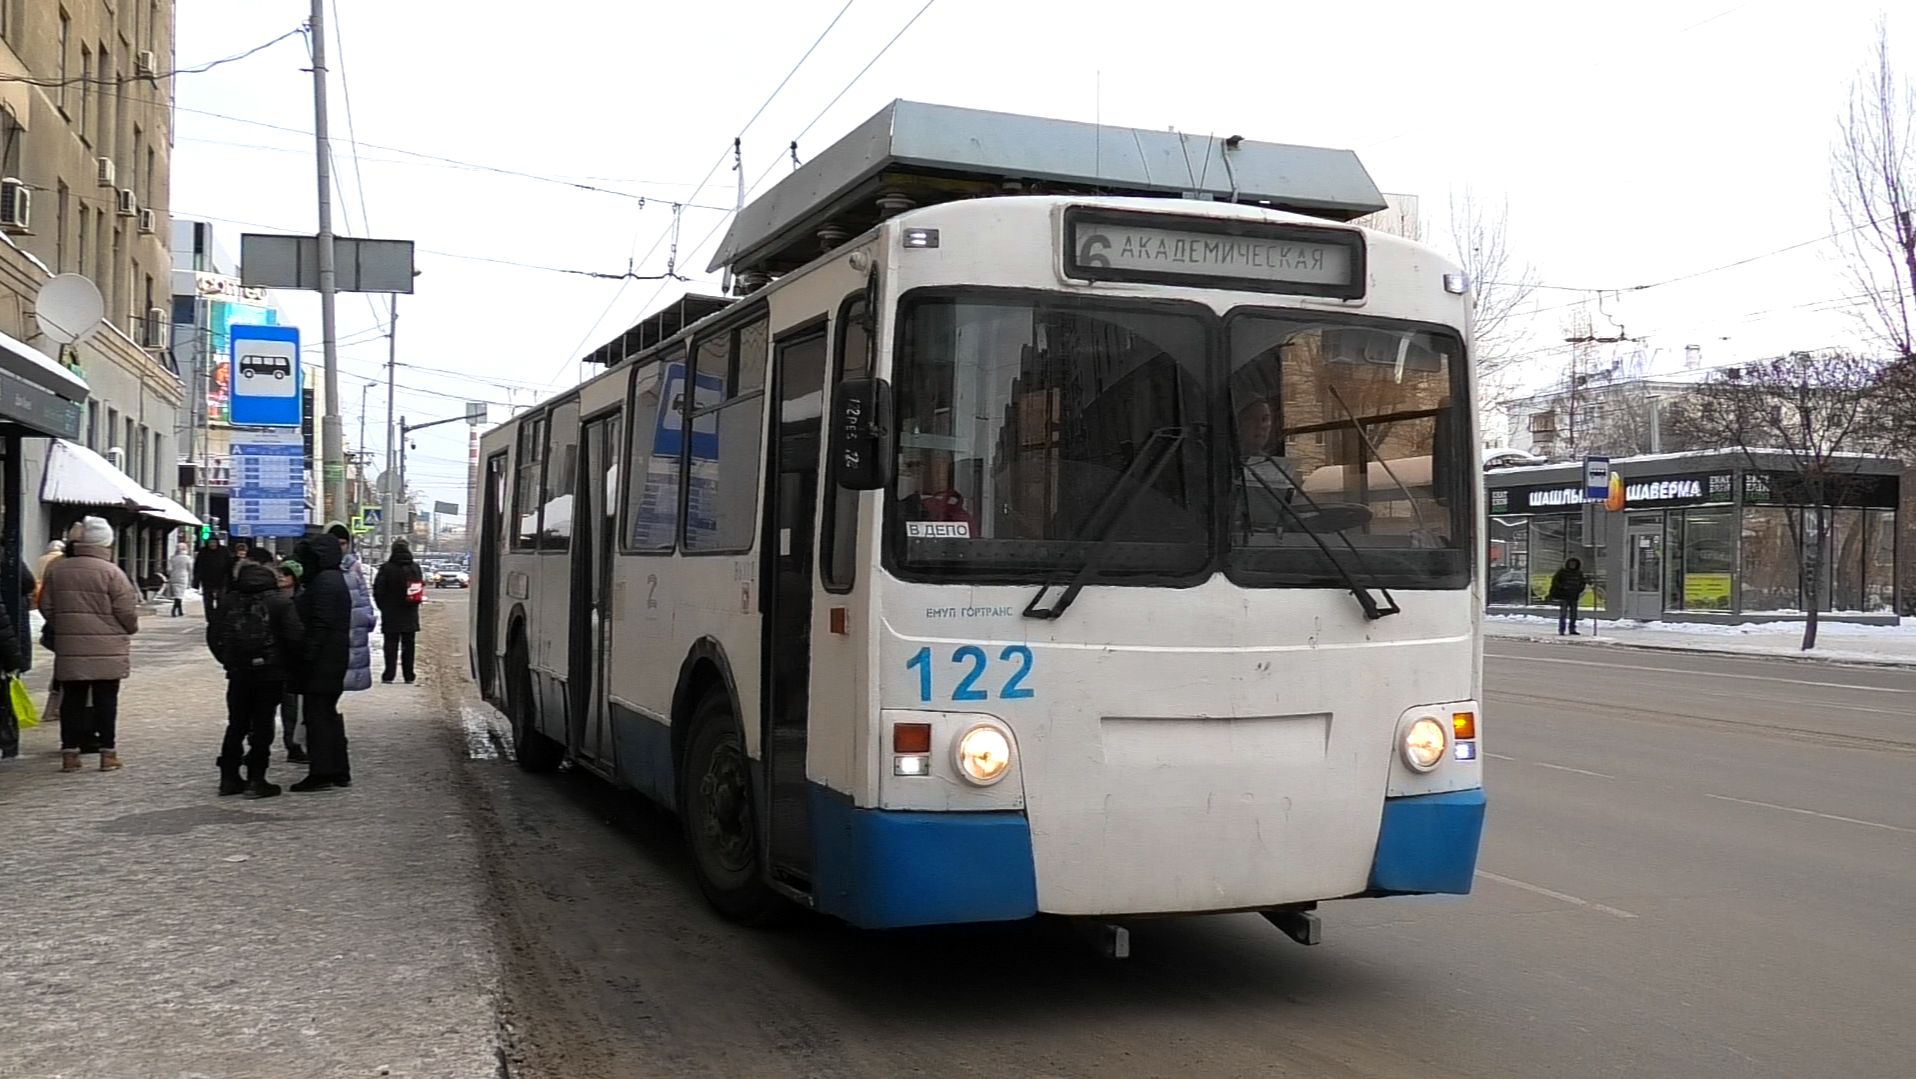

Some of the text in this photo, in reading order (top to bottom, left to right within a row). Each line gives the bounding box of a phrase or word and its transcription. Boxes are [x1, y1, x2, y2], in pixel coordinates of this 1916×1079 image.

[1080, 234, 1325, 271] 6 АКАДЕМИЧЕСКАЯ
[1626, 480, 1702, 501] ШАВЕРМА
[909, 524, 968, 538] В ДЕПО
[926, 606, 1014, 619] ЕМУП ГОРТРАНС
[906, 645, 1036, 703] 122
